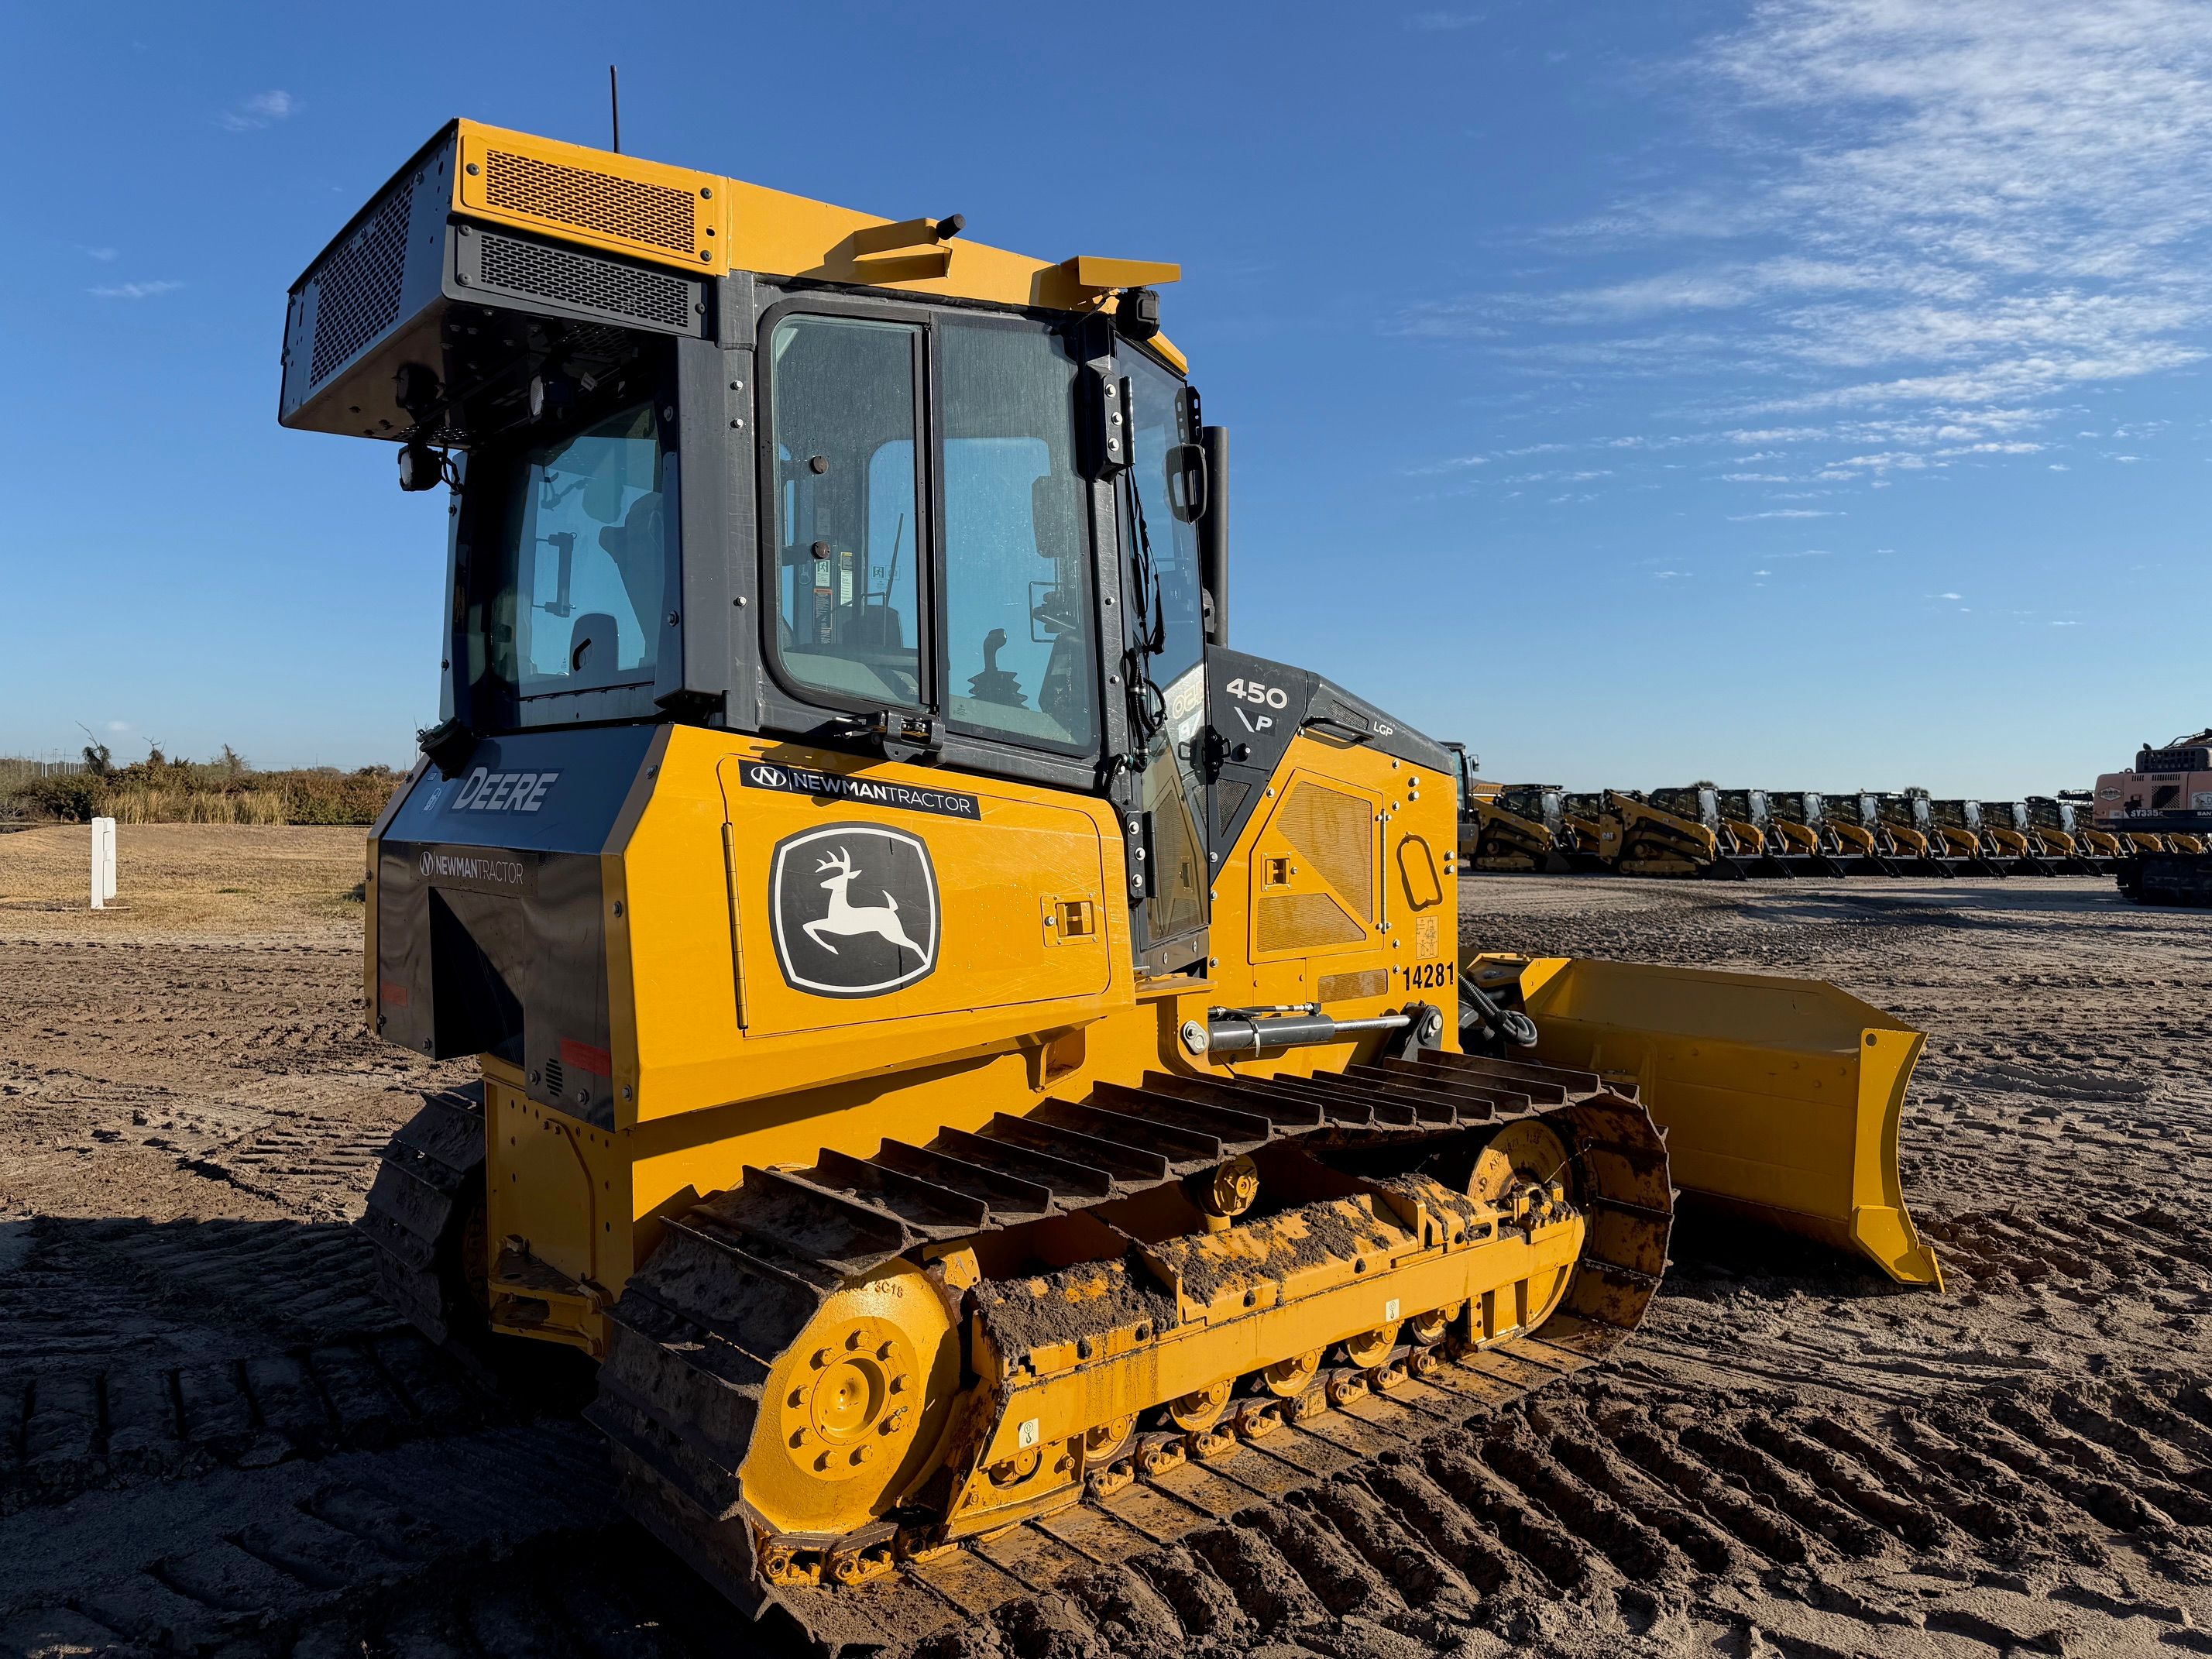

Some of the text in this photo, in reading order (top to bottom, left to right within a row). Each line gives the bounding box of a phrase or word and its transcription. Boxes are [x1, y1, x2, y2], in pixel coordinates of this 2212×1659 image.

[1226, 678, 1288, 709] 450
[1373, 721, 1393, 737] LGP
[452, 767, 558, 812] DEERE
[793, 772, 971, 813] NEWMANTRACTOR
[1602, 832, 1613, 840] CAT
[435, 855, 524, 884] NEWMANTRACTOR
[1403, 961, 1454, 991] 14281
